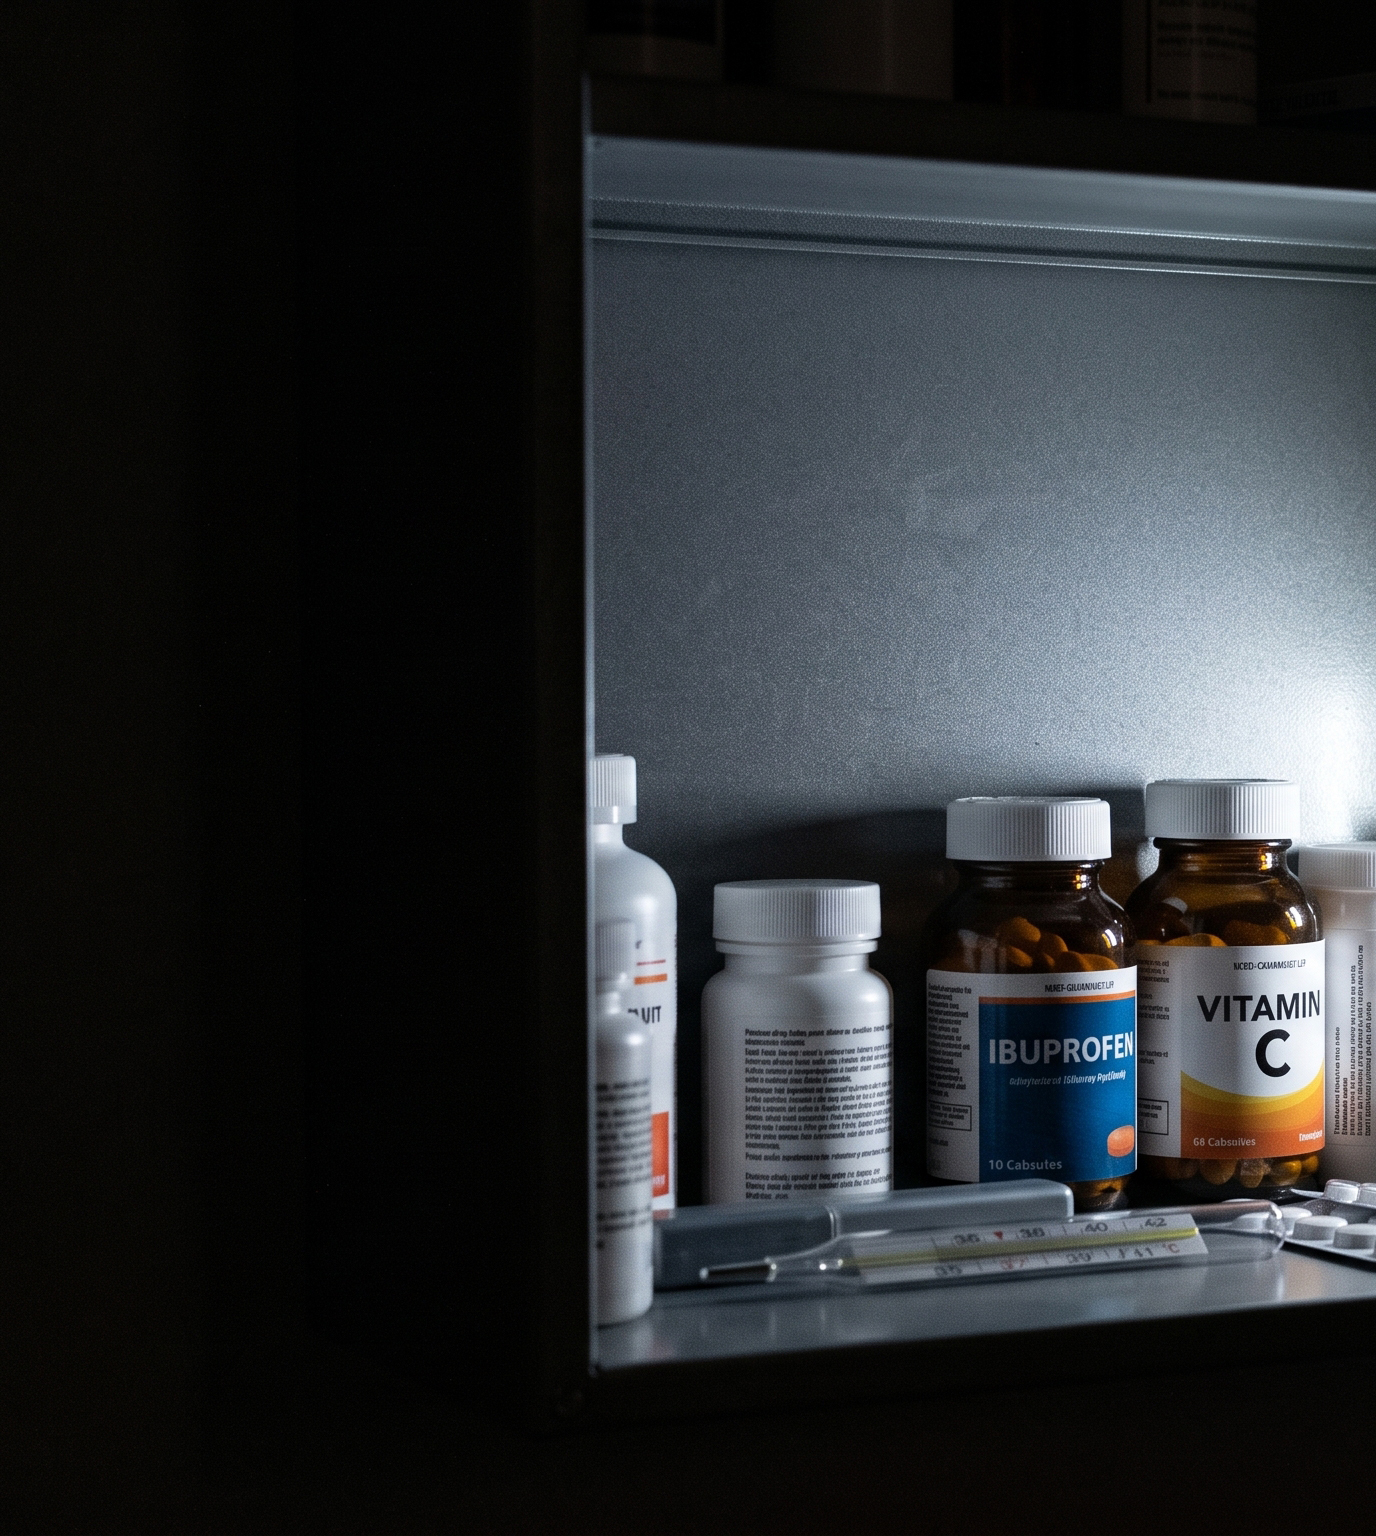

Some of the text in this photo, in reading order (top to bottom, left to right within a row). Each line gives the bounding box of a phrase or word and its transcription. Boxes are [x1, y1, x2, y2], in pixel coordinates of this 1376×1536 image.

[1197, 989, 1321, 1022] VITAMIN
[988, 1030, 1134, 1065] IBUPROFEN
[1255, 1028, 1291, 1078] C
[988, 1159, 1063, 1171] 10 Cabsutes
[1085, 1222, 1109, 1232] 40
[1144, 1217, 1168, 1227] 42
